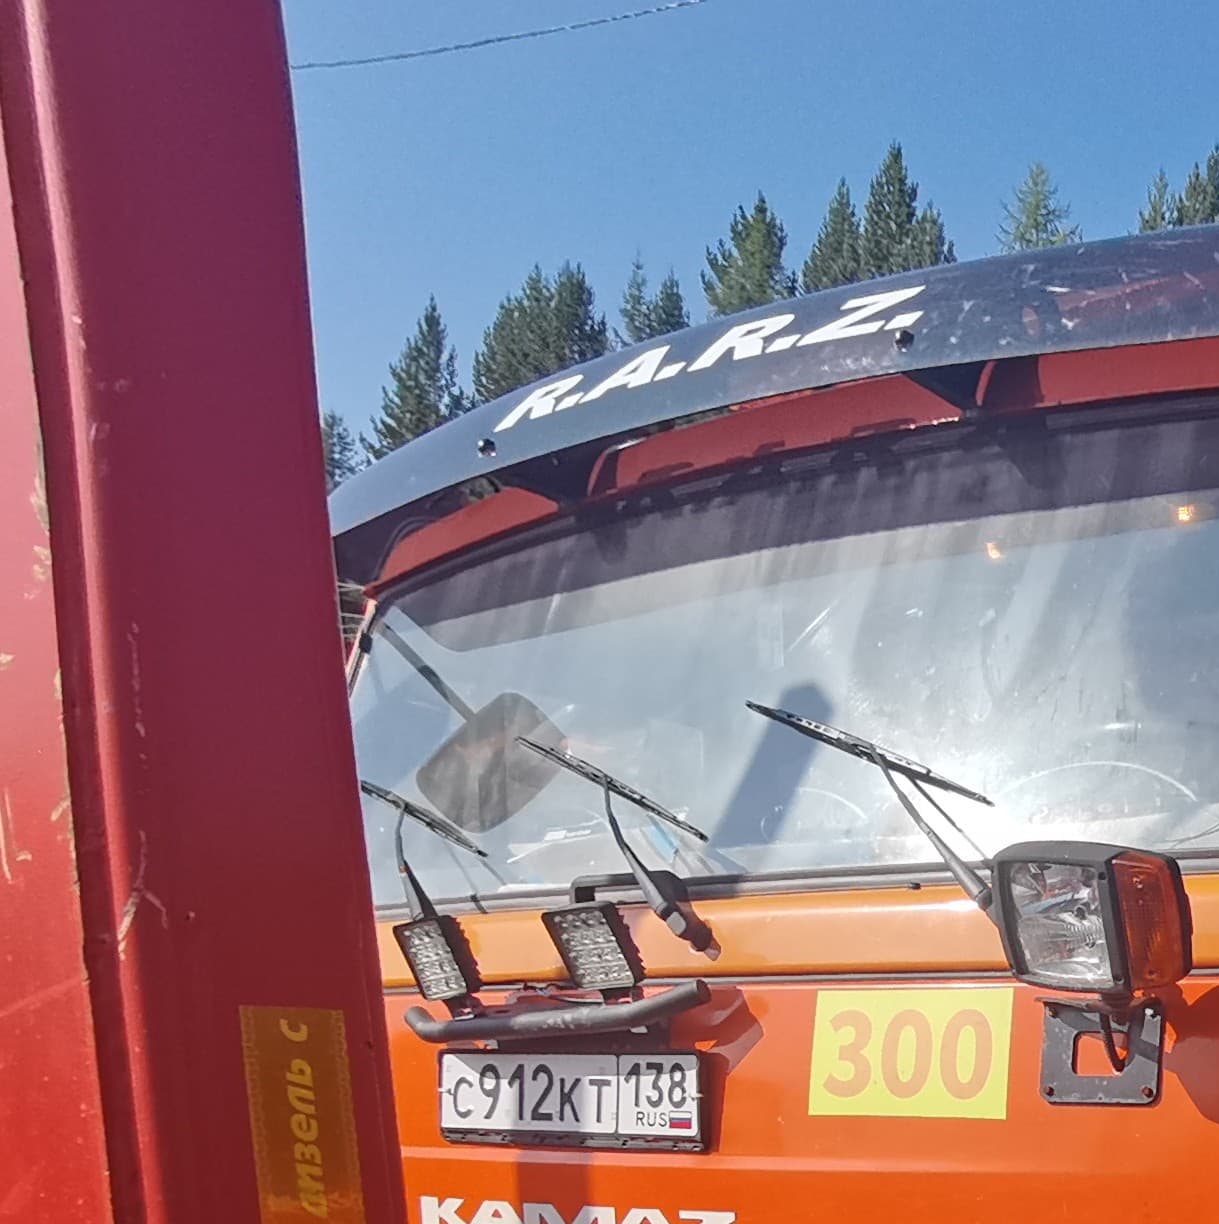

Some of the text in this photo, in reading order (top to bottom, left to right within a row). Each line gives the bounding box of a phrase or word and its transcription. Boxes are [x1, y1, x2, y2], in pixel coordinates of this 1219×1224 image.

[494, 285, 927, 433] R.A.R.Z.
[822, 1008, 993, 1100] 300
[452, 1062, 687, 1123] С912КТ 138
[635, 1111, 668, 1128] RUS
